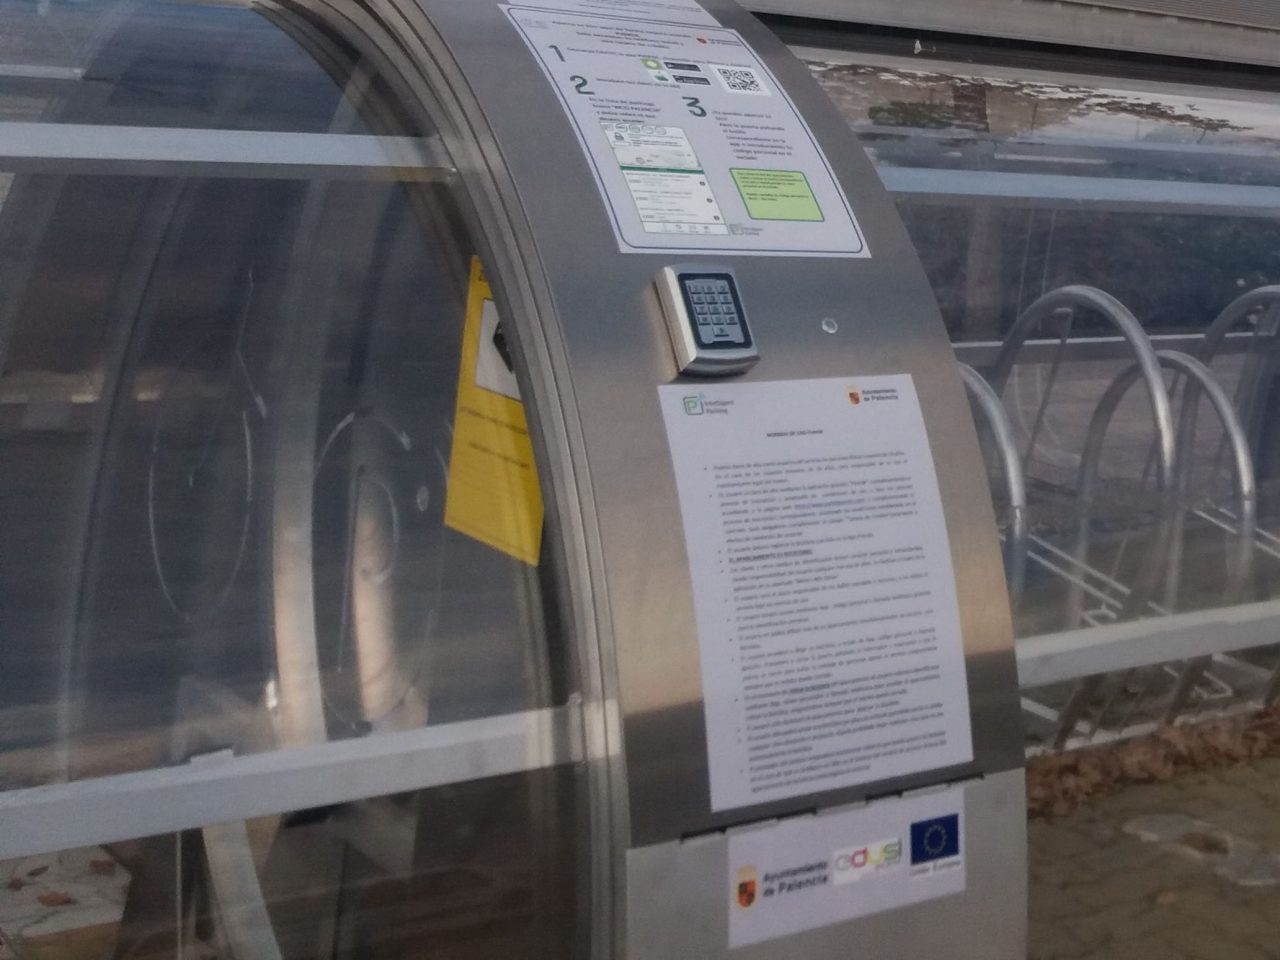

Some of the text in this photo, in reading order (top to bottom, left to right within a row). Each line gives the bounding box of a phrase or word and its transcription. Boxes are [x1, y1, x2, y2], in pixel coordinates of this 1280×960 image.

[549, 44, 565, 62] 1
[569, 75, 595, 95] 2
[682, 96, 707, 117] 3
[778, 875, 828, 894] Palencia
